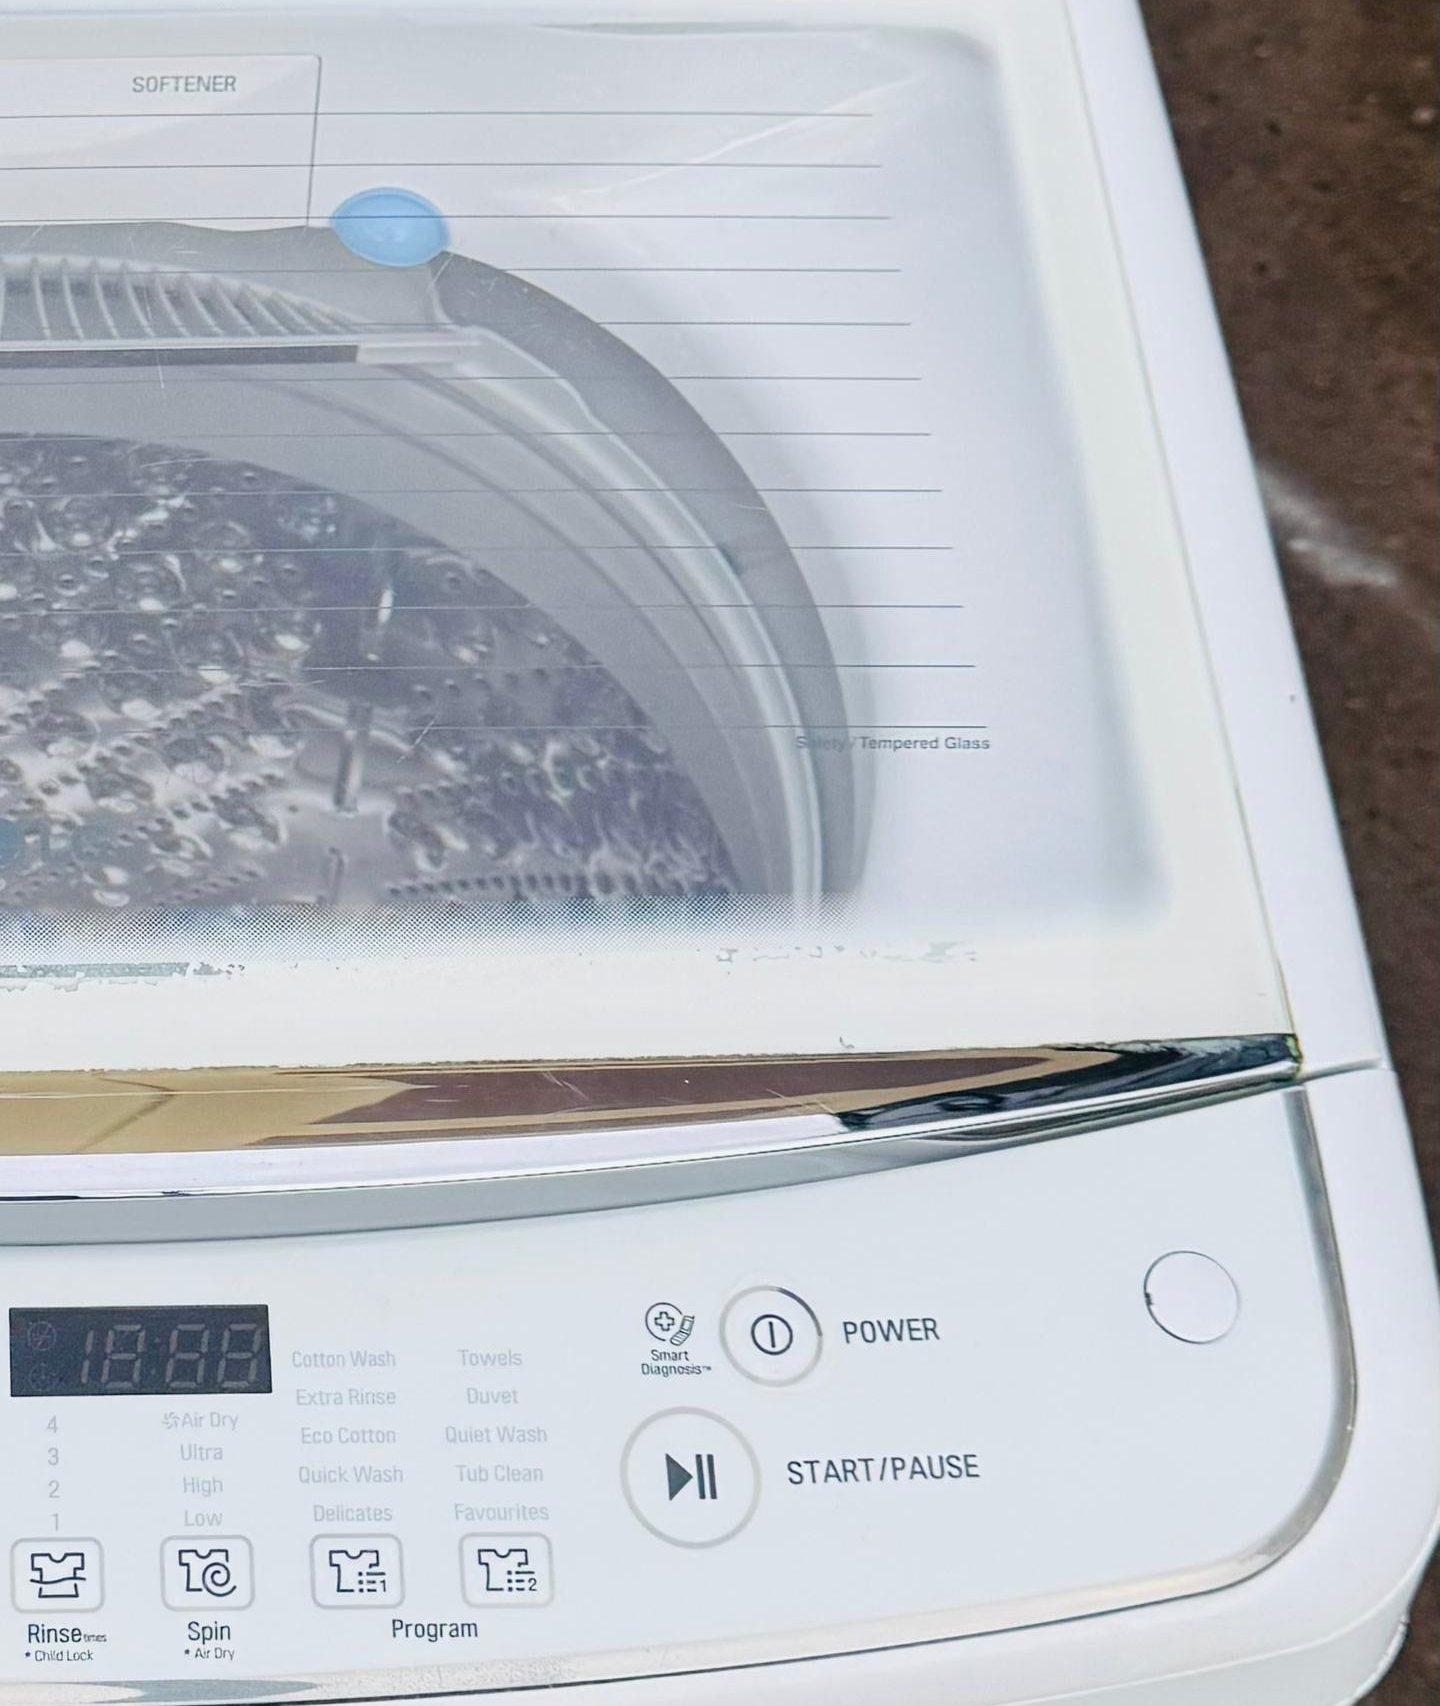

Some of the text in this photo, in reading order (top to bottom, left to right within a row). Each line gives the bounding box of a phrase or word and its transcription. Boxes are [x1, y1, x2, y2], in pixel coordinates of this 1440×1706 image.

[131, 74, 237, 94] SOFTENER
[860, 736, 939, 752] Tempered
[944, 737, 990, 749] Glass
[842, 1317, 941, 1345] POWER
[291, 1350, 397, 1369] Cotton Wash
[457, 1348, 523, 1367] Towels
[650, 1348, 690, 1362] Smart
[295, 1388, 397, 1406] Extra Rinse
[466, 1387, 519, 1405] Duvet
[45, 1415, 59, 1434] 4
[181, 1411, 239, 1432] Air Dry
[300, 1426, 397, 1445] Eco Cotton
[444, 1425, 548, 1445] Quiet Wash
[47, 1446, 60, 1467] 3
[179, 1443, 224, 1462] Ultra
[298, 1465, 404, 1485] Quick Wash
[455, 1464, 544, 1483] Tub Clean
[786, 1453, 980, 1486] START/PAUSE
[48, 1479, 61, 1499] 2
[182, 1476, 224, 1498] High
[183, 1509, 223, 1527] Low
[312, 1504, 393, 1523] Delicates
[453, 1502, 550, 1522] Favourites
[51, 1512, 59, 1532] 1
[27, 1623, 83, 1644] Rinse
[187, 1620, 231, 1646] Spin
[391, 1618, 479, 1643] Program
[34, 1649, 94, 1662] Child Lock
[194, 1646, 236, 1662] Air Dry
